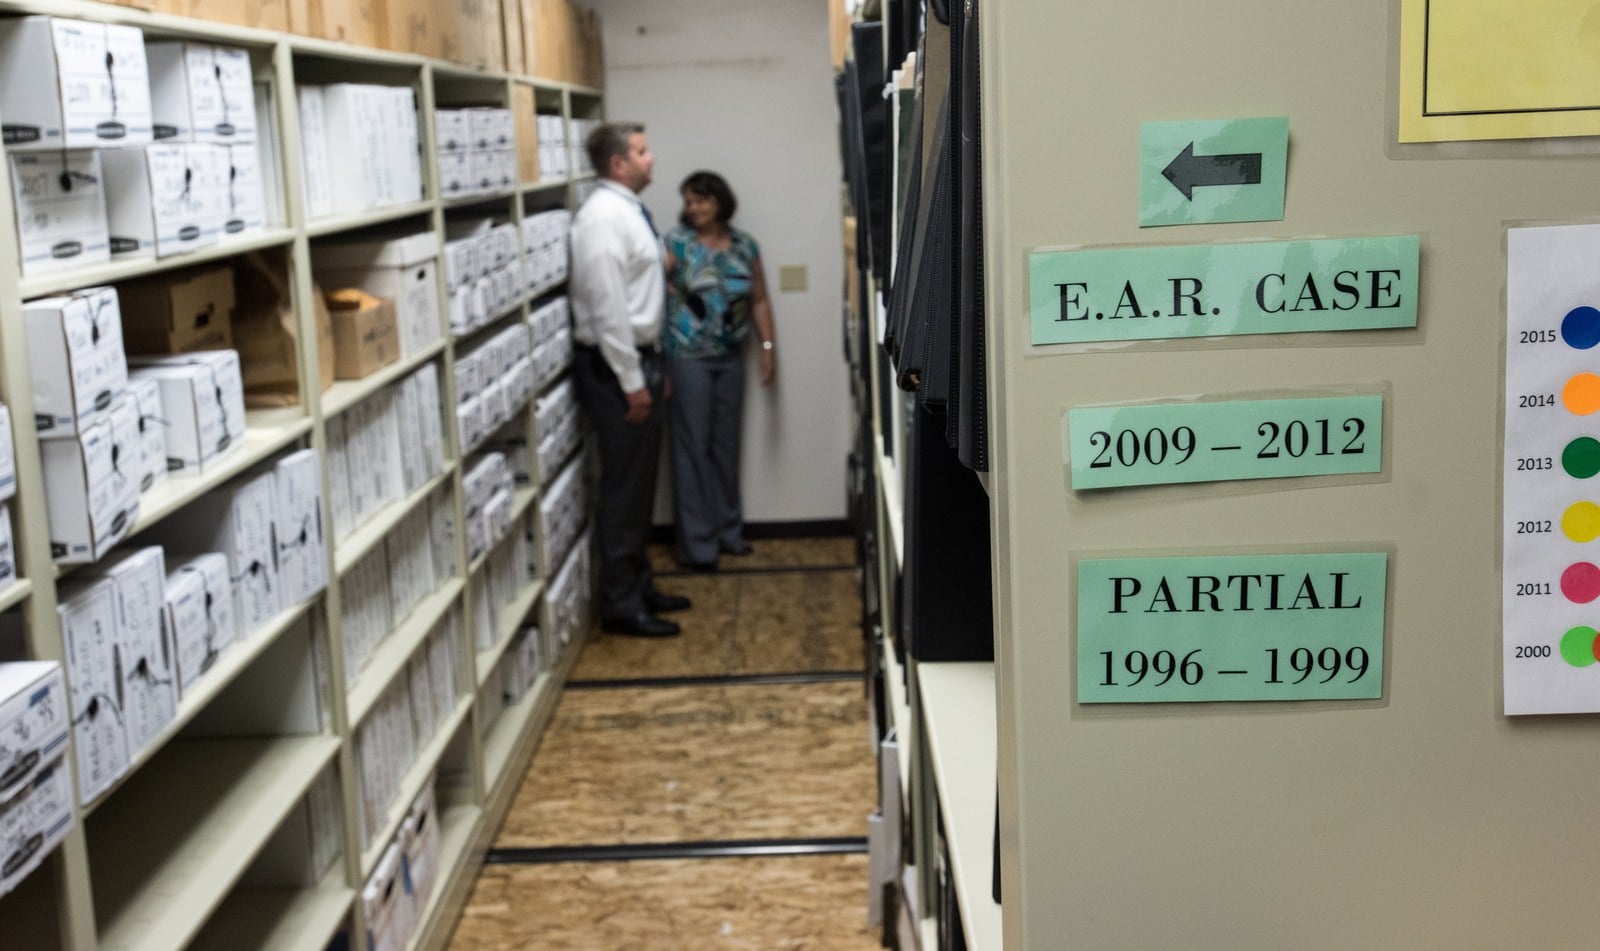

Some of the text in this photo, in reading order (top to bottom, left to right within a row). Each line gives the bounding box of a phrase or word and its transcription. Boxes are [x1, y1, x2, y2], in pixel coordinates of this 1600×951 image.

[1054, 269, 1402, 322] E.A.R. CASE
[1520, 330, 1556, 344] 2015
[1519, 394, 1555, 408] 2014
[1089, 426, 1196, 469] 2009
[1257, 418, 1365, 459] 2012
[1517, 457, 1553, 471] 2013
[1517, 520, 1552, 534] 2012
[1108, 573, 1362, 613] PARTIAL
[1516, 583, 1552, 596] 2011
[1515, 645, 1551, 658] 2000
[1099, 649, 1204, 687] 1996
[1264, 646, 1369, 685] 1999
